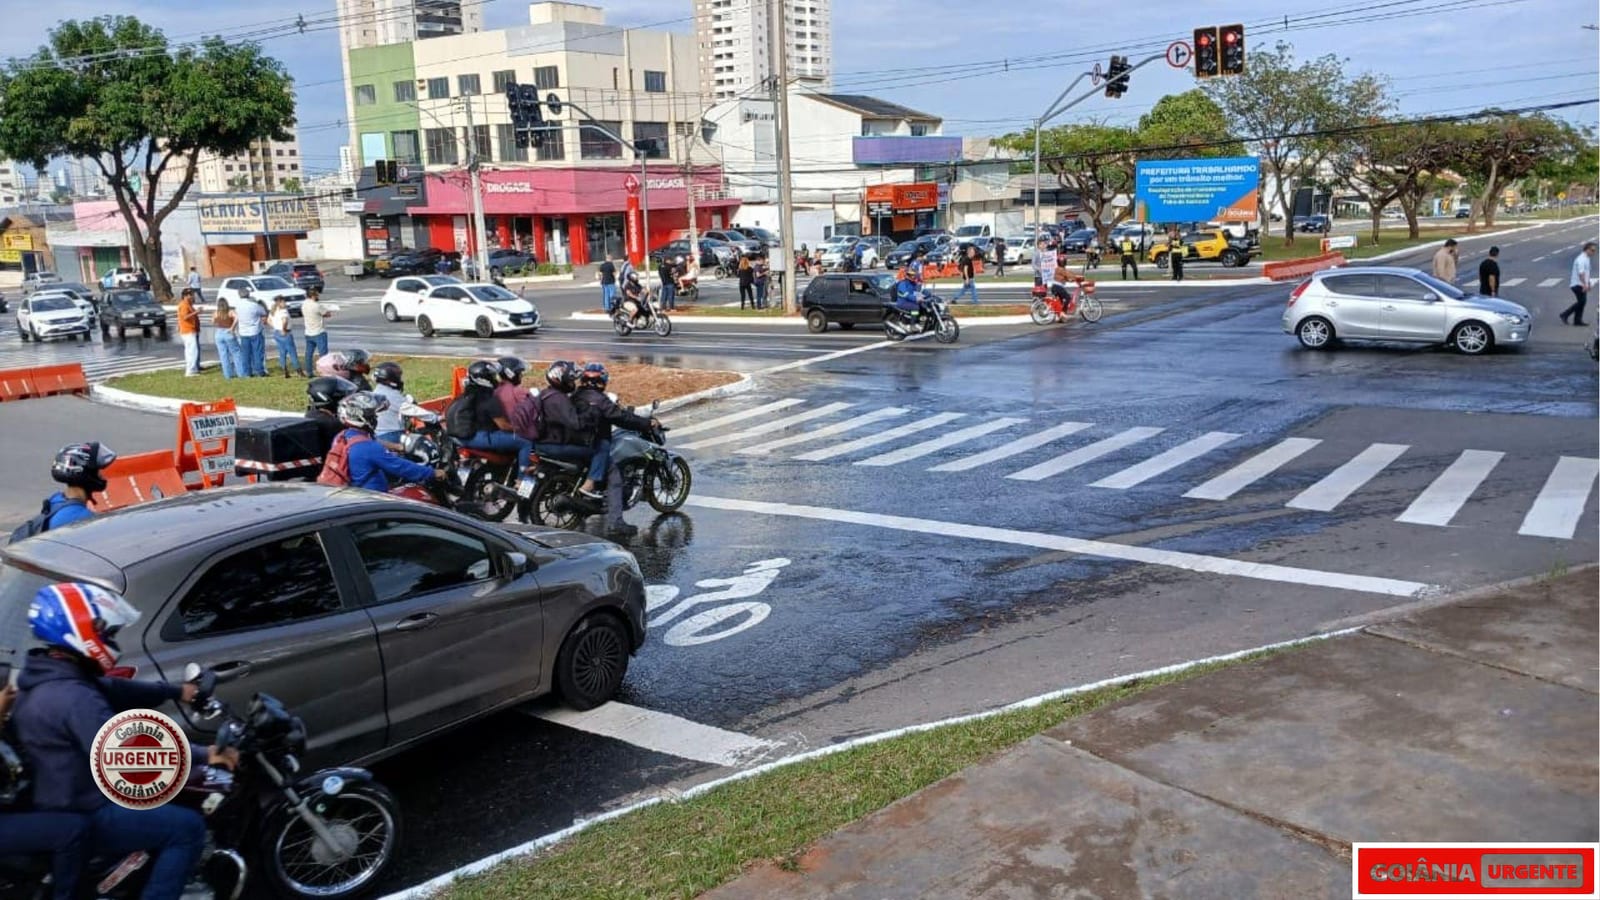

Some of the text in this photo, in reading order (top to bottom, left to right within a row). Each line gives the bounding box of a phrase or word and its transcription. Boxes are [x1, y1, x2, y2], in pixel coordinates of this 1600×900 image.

[1141, 165, 1256, 175] PREFEITURA TRABALHANDO
[487, 182, 533, 193] DROGASIL
